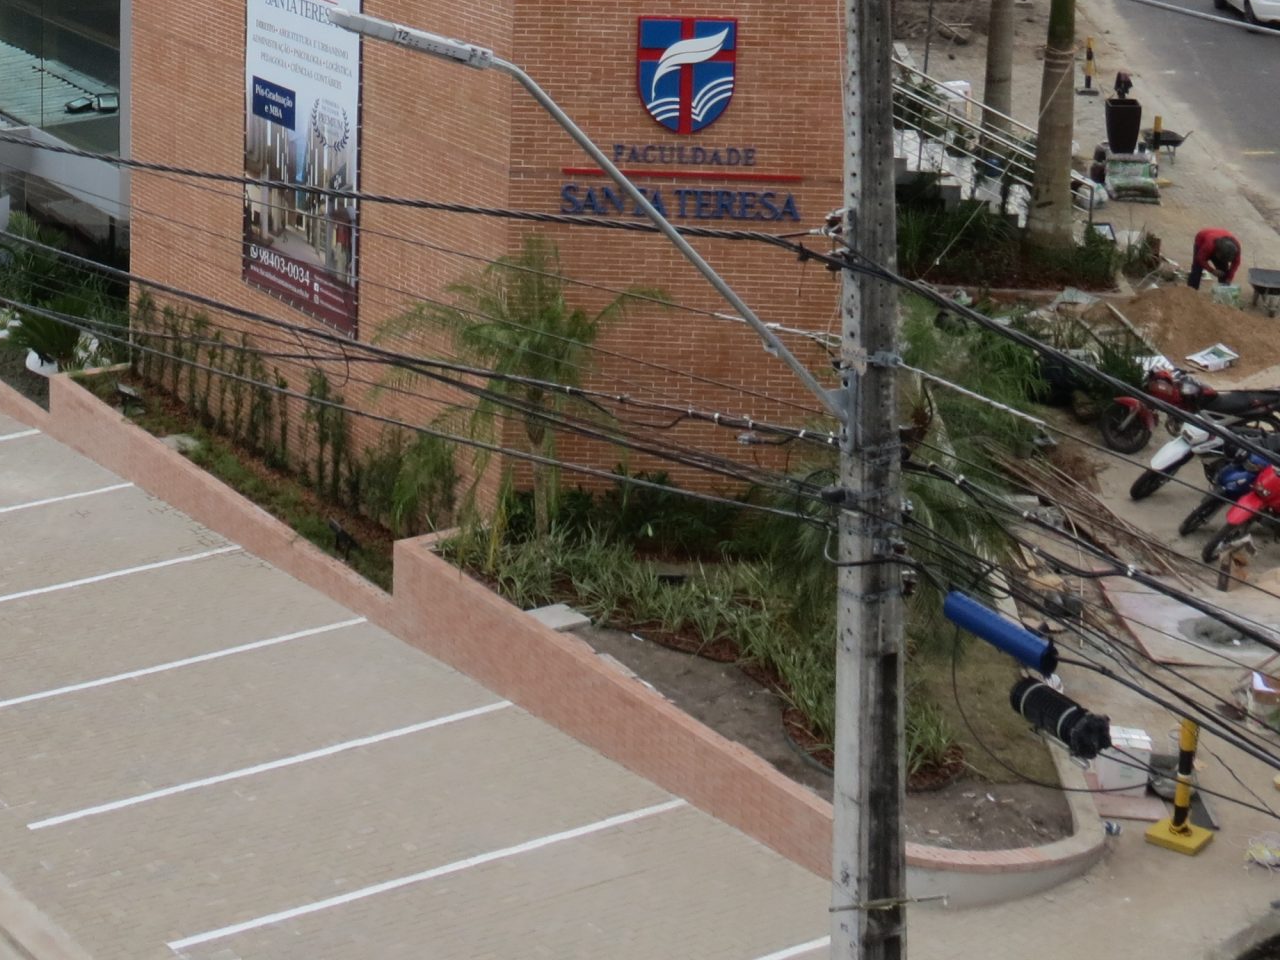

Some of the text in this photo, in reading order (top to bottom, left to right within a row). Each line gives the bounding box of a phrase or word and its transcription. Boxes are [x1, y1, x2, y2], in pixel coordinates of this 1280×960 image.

[255, 19, 276, 34] DIREITO
[255, 84, 293, 108] Pós-Graduação
[270, 104, 283, 120] MBA
[613, 144, 757, 166] FACULDADE
[674, 189, 801, 221] TERESA
[259, 248, 310, 286] 98403-0034
